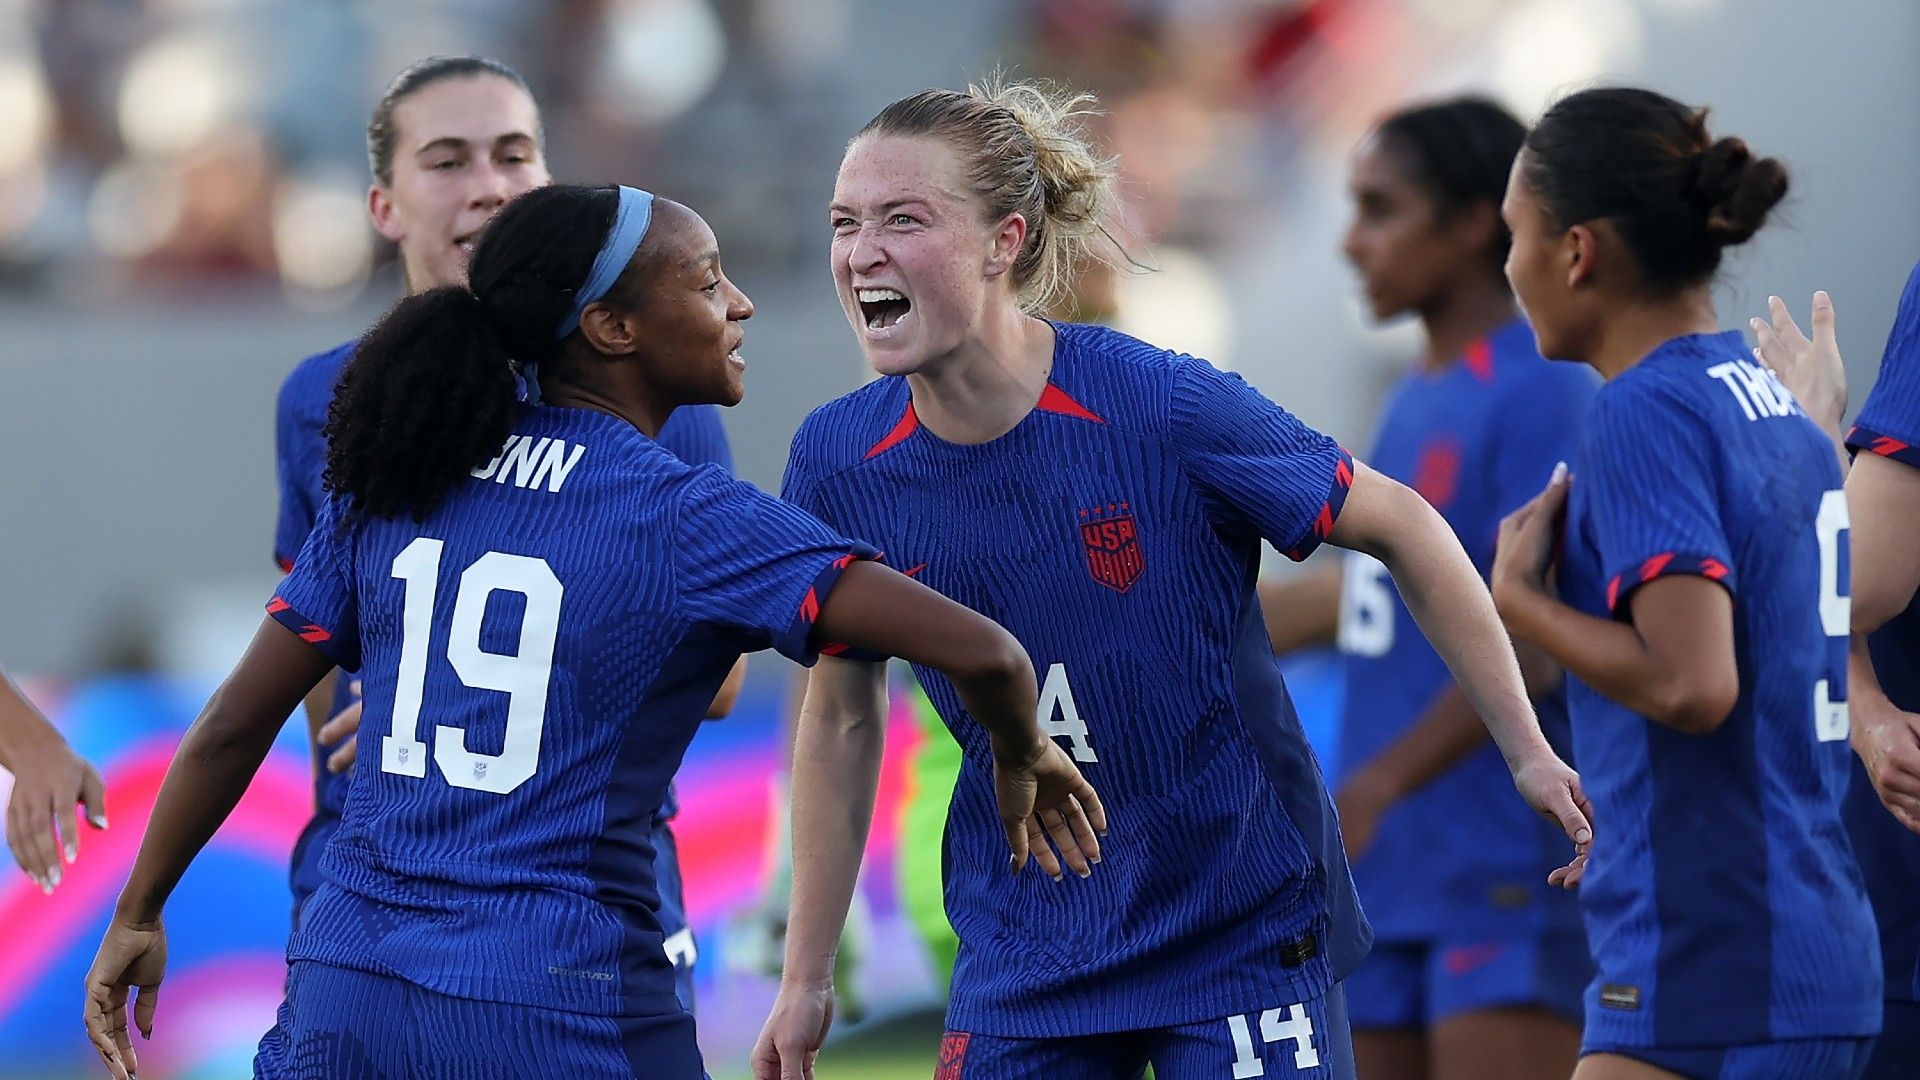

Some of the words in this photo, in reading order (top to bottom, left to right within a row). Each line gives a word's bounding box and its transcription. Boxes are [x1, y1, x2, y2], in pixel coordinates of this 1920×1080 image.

[1085, 520, 1134, 551] USA
[381, 536, 564, 794] 19
[1227, 1003, 1320, 1080] 14
